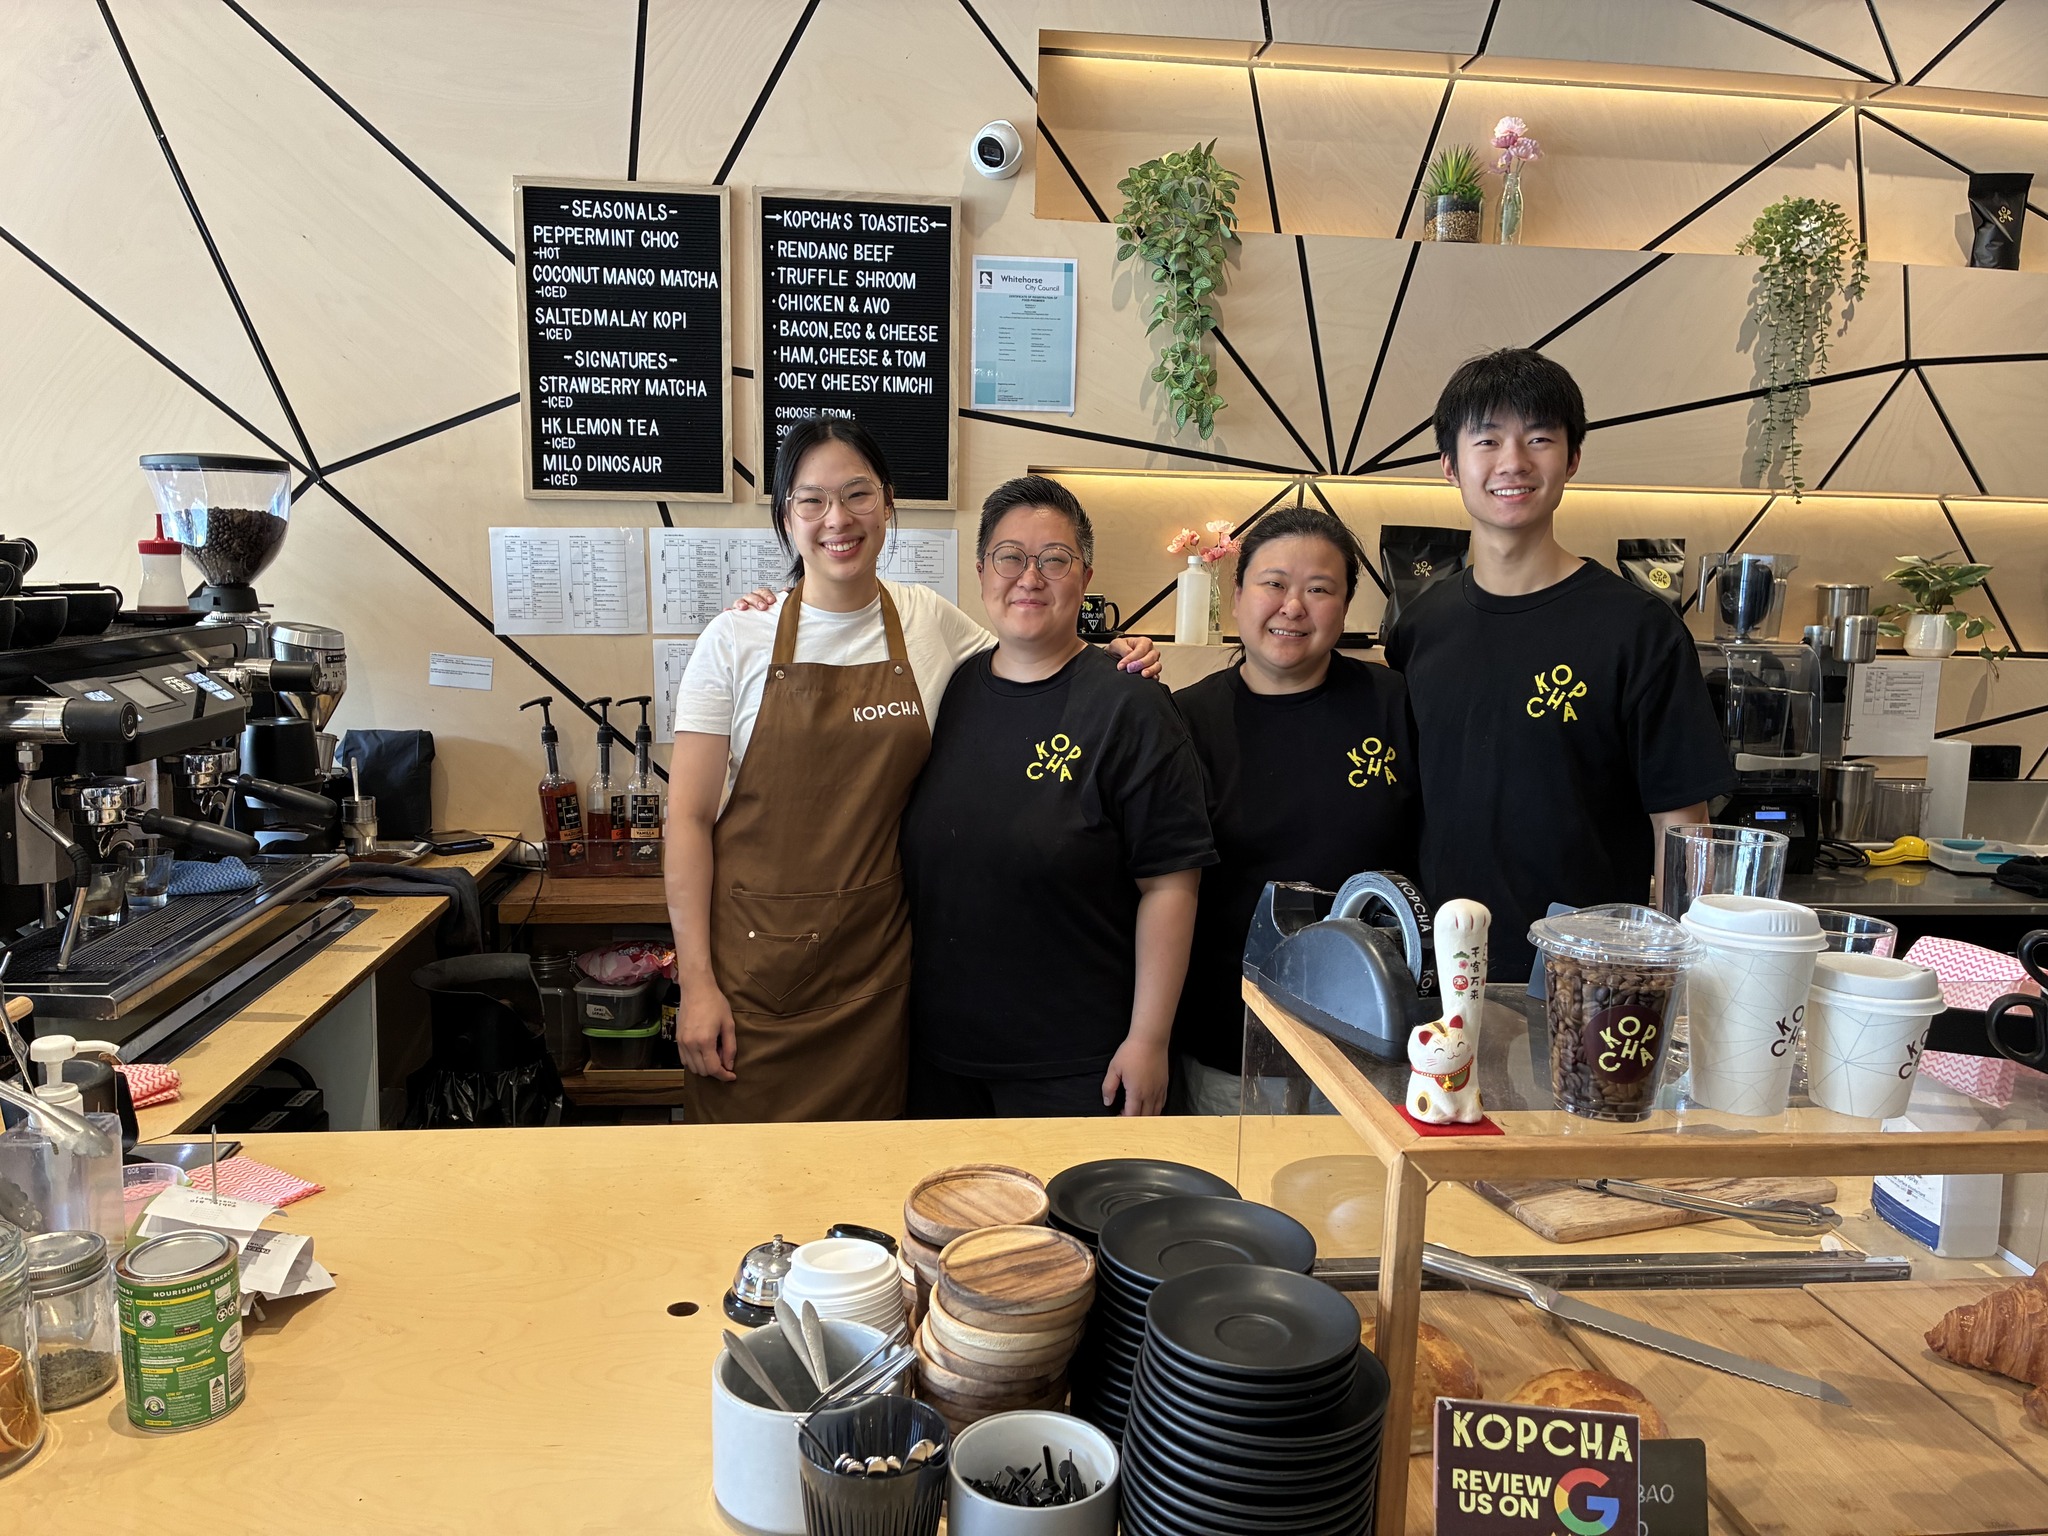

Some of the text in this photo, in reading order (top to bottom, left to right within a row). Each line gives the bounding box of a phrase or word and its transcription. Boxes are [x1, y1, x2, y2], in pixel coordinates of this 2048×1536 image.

[783, 210, 929, 233] KOPCHA'S TOASTIES
[533, 225, 679, 248] PEPPERMINT CHOC
[777, 240, 894, 262] RENDANG BEEF
[532, 265, 718, 289] COCONUT MANGO MATCHA
[777, 266, 916, 290] TRUFFLE SHROOM
[1000, 275, 1043, 284] Whitehorse
[1025, 284, 1060, 292] City Council
[778, 293, 890, 314] CHICKEN & AVO
[653, 311, 686, 330] KOPI
[865, 322, 876, 340] &
[879, 324, 939, 342] CHEESE
[881, 349, 892, 367] &
[895, 349, 926, 368] TOM
[539, 375, 708, 398] STRAWBERRY MATCHA
[779, 372, 933, 395] OOEY CHEESY KIMCHI
[775, 406, 817, 419] CHOOSE
[541, 417, 659, 436] HK LEMON TEA
[543, 454, 662, 473] MILO DINOSAUR
[852, 700, 921, 723] KOPCHA
[1397, 881, 1432, 932] KOPCHA
[153, 1268, 234, 1298] NOURISHING ENERGY
[1452, 1410, 1633, 1463] KOPCHA
[1452, 1468, 1552, 1498] REVIEW
[1458, 1491, 1539, 1520] US ON
